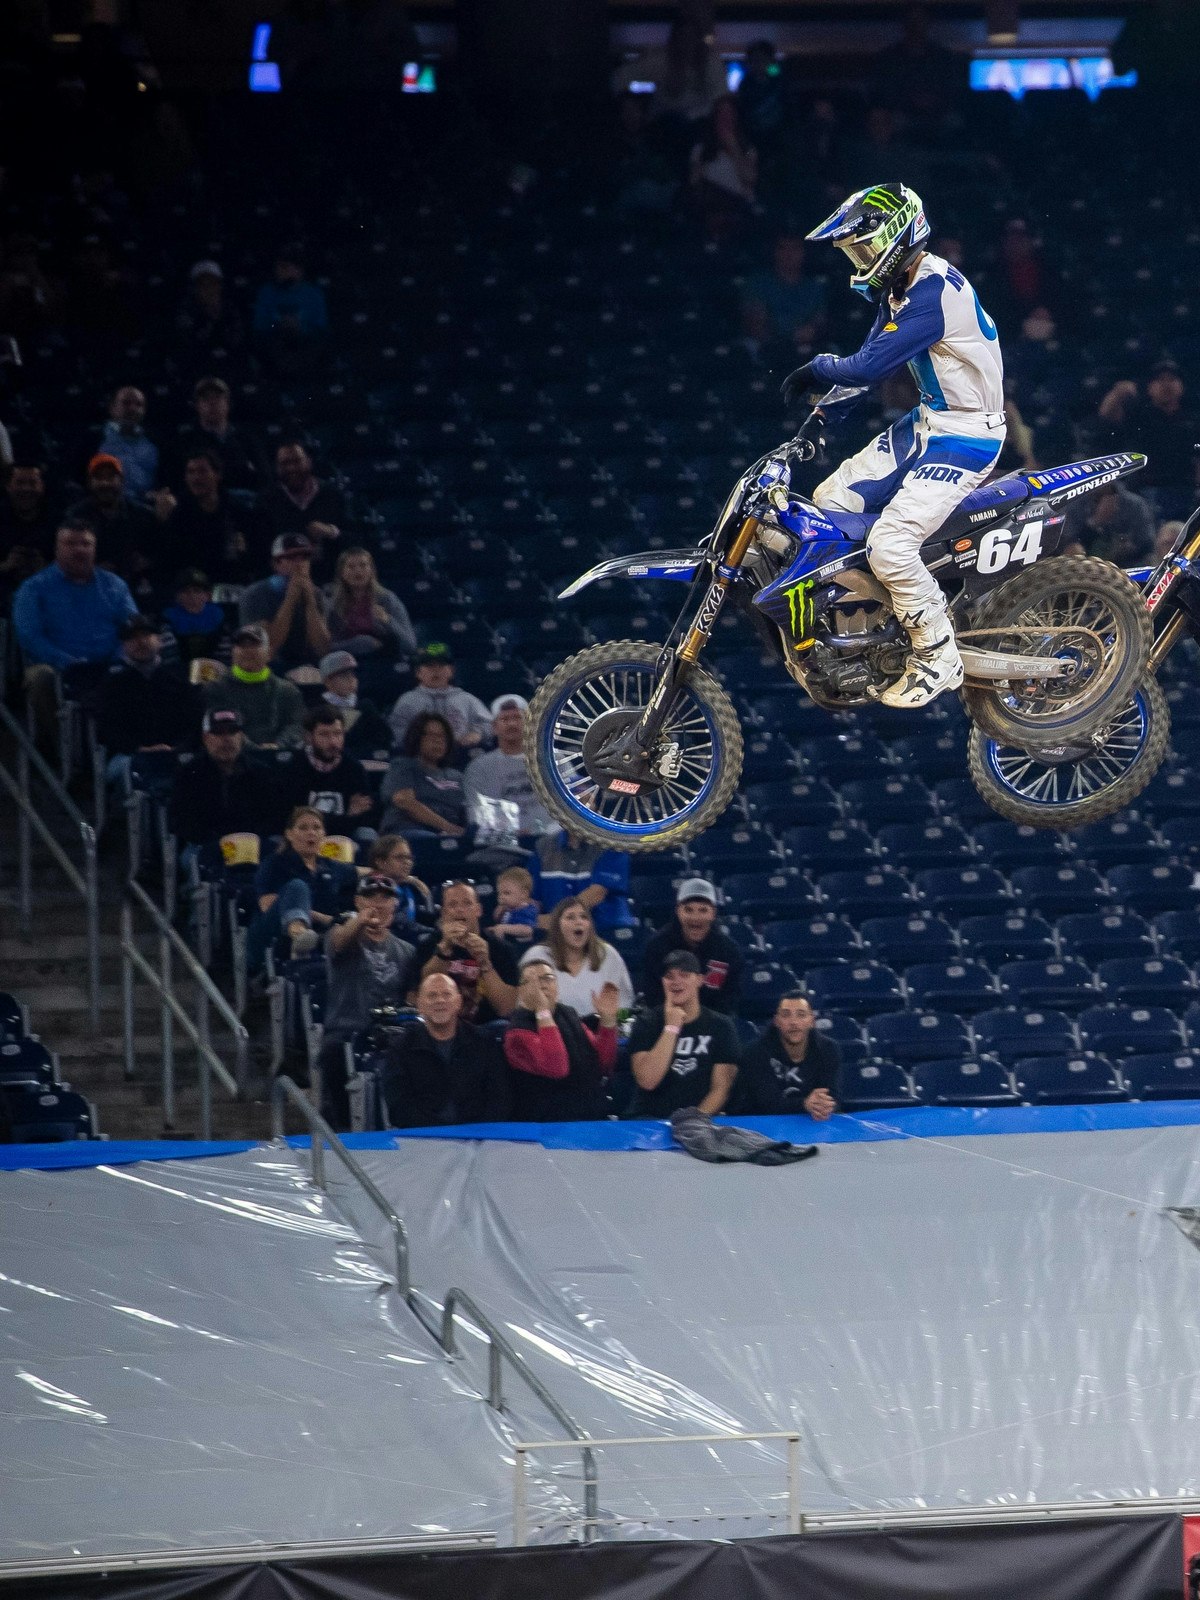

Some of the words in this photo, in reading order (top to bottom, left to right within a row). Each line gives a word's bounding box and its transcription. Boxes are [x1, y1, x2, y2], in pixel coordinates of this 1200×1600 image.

[876, 244, 905, 278] MONSTER
[1066, 470, 1121, 500] DUNLOP
[969, 509, 998, 523] YAMAHA
[976, 520, 1043, 574] 64
[819, 560, 845, 578] YAMALUBE
[696, 583, 725, 635] KYB
[675, 1034, 713, 1055] OX
